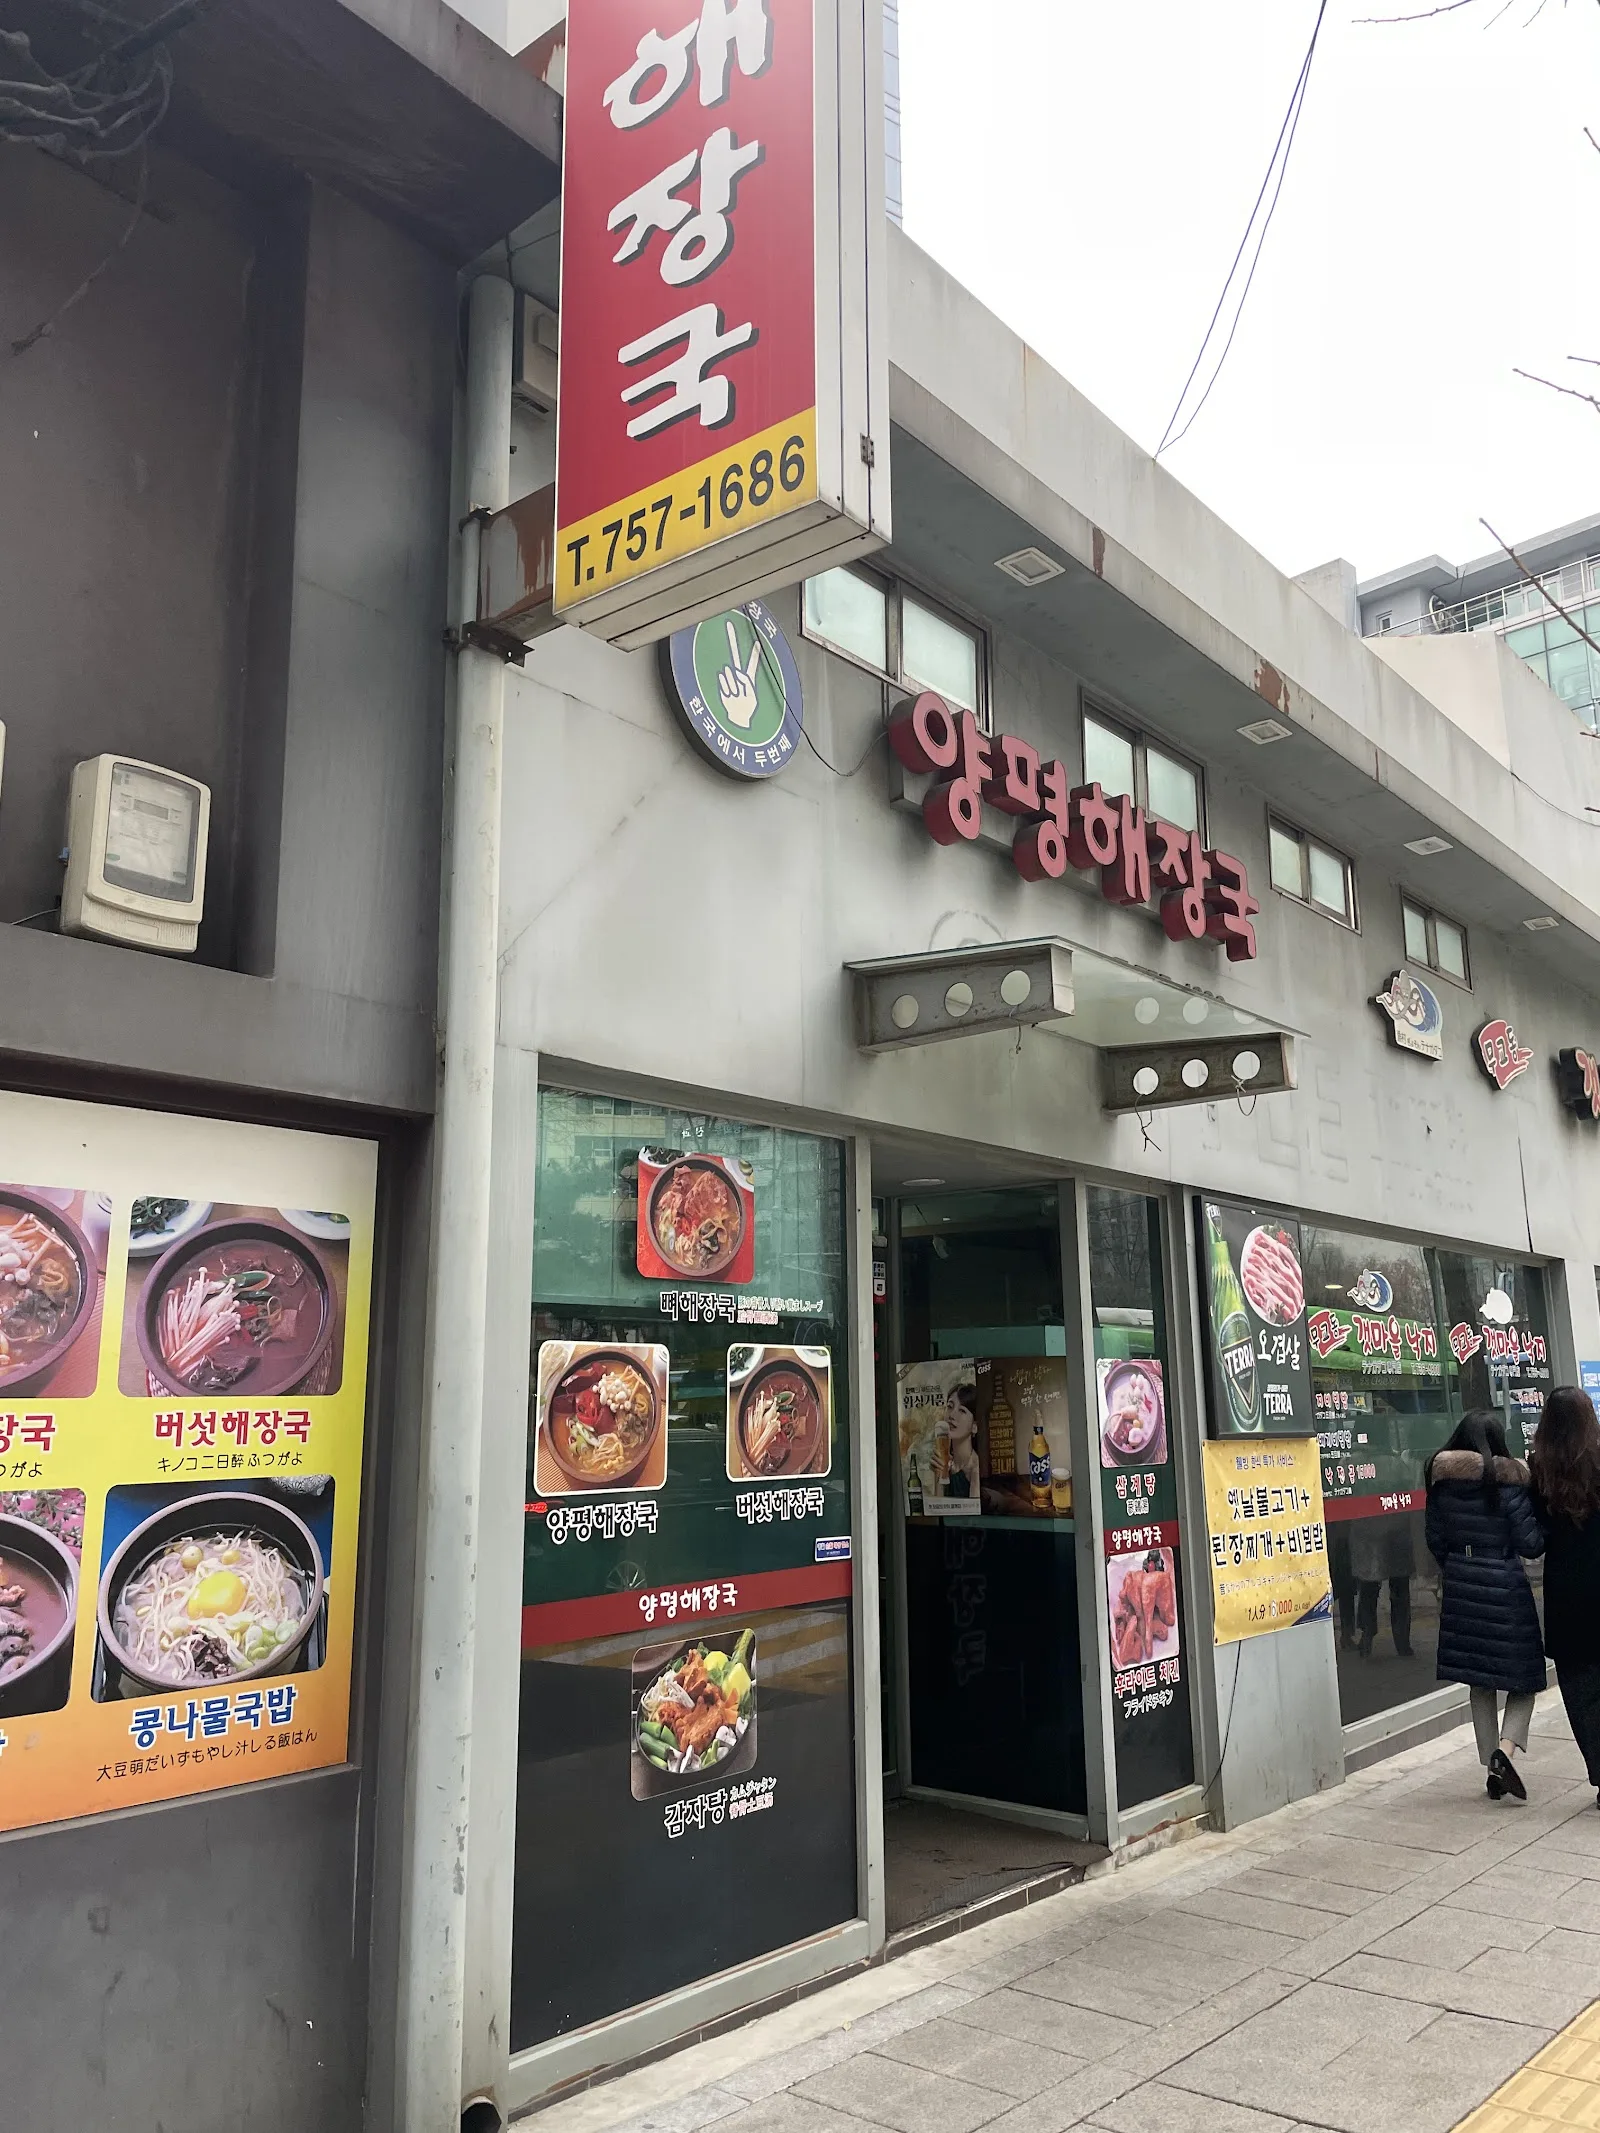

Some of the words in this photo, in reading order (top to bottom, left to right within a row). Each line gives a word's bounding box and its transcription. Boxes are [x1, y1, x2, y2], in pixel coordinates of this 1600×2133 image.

[603, 0, 767, 442] 해장국
[566, 435, 806, 588] T.757-1686
[689, 696, 745, 764] 한국에서
[755, 734, 792, 768] 두번째
[891, 691, 1260, 961] 양평해장국
[1484, 1026, 1518, 1077] 무교동
[660, 1290, 736, 1323] 뼈해장국
[1257, 1329, 1300, 1371] 오겹살
[1311, 1313, 1339, 1349] 무교동
[1352, 1314, 1403, 1360] 갯마을
[1405, 1322, 1437, 1361] 낙지
[1482, 1325, 1519, 1365] 갯마을
[1522, 1331, 1546, 1366] 낙지
[1224, 1343, 1254, 1378] TERRA
[1263, 1393, 1293, 1416] TERRA
[156, 1411, 311, 1447] 버섯해장국
[1030, 1456, 1050, 1475] Cass
[1116, 1473, 1156, 1499] 삼계탕
[546, 1500, 658, 1544] 양평해장국
[736, 1487, 824, 1525] 버섯해장국
[1228, 1486, 1310, 1521] 옛날불고기+
[1112, 1526, 1162, 1550] 양평해장국
[639, 1583, 738, 1622] 양평해장국
[1114, 1665, 1156, 1699] 후라이드
[1159, 1658, 1180, 1686] 치킨
[130, 1686, 296, 1749] 콩나물국밥
[1123, 1690, 1173, 1718] フライドチキン
[664, 1788, 728, 1838] 감자탕
